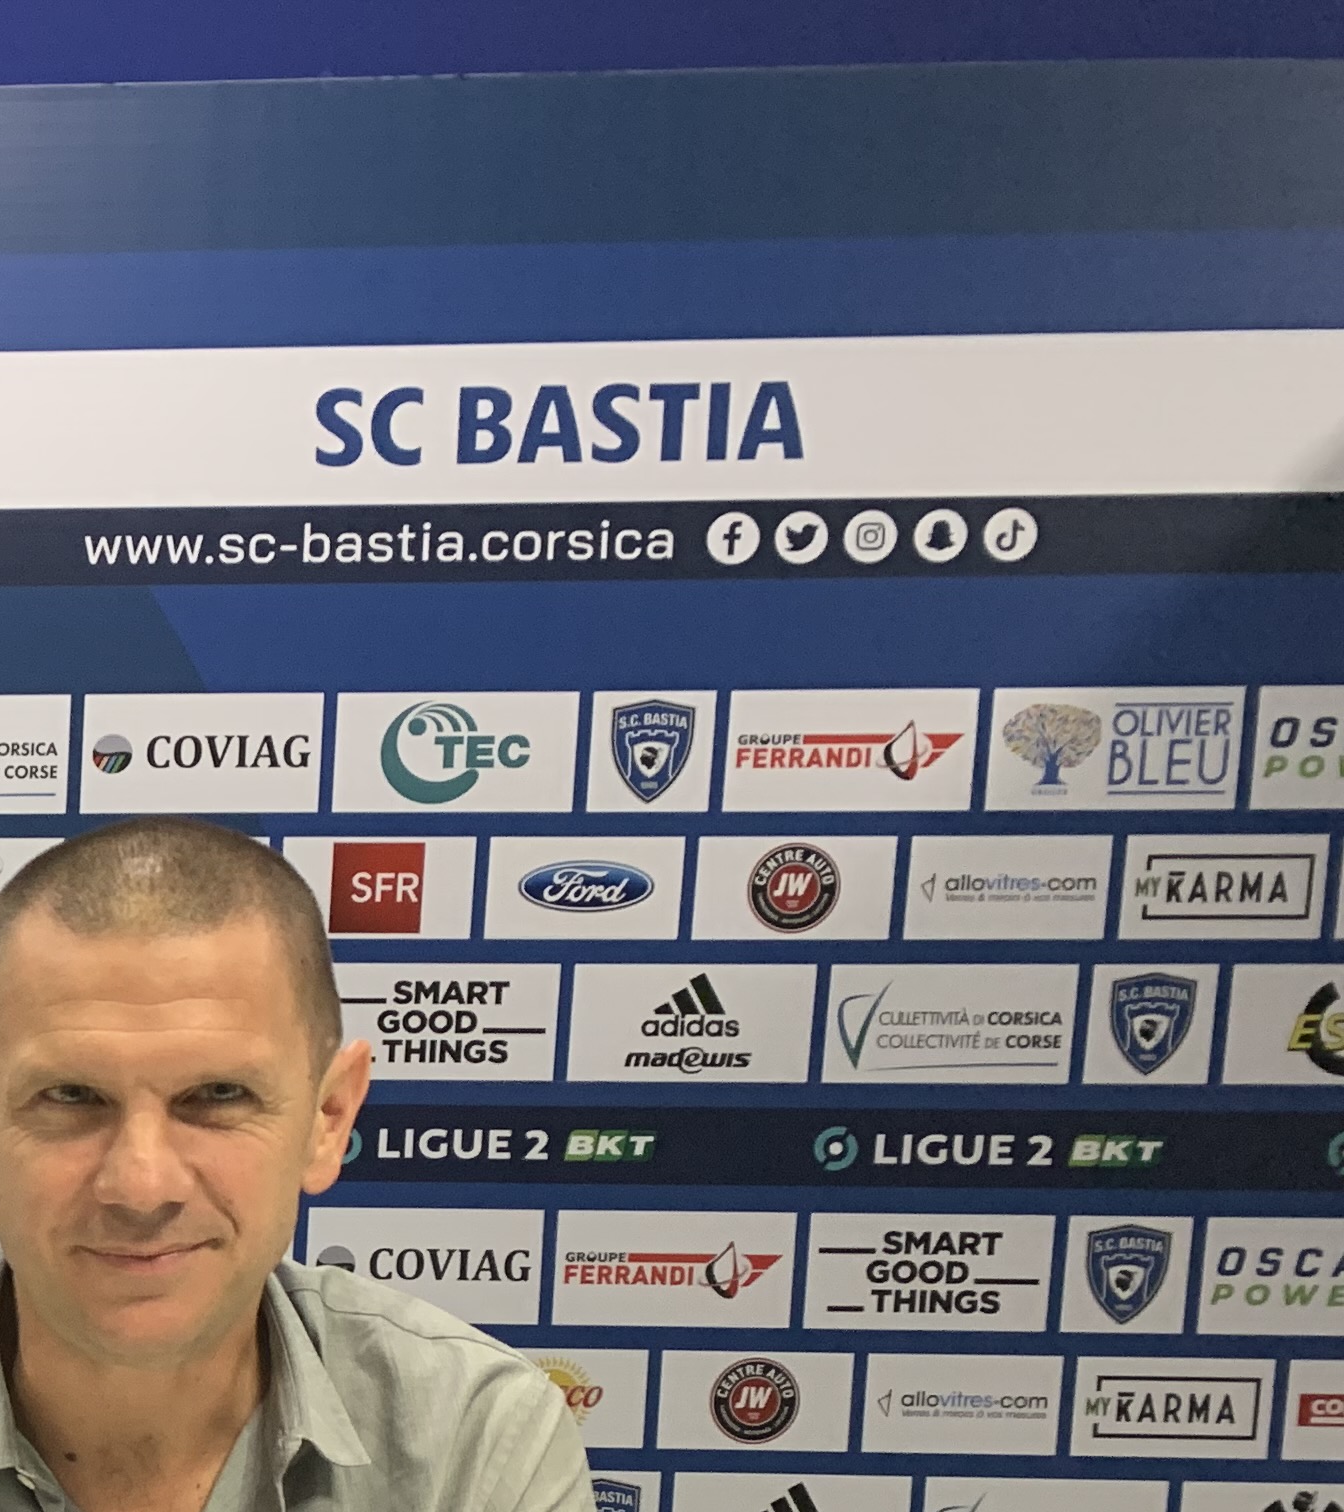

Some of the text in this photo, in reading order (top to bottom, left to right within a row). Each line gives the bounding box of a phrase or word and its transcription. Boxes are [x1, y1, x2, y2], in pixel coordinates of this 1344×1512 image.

[313, 380, 804, 467] SC BASTIA
[85, 519, 674, 567] www.sc-bastia.corsica
[618, 711, 688, 730] S.C. BASTIA
[1113, 709, 1231, 737] OLIVIER
[147, 734, 311, 769] COVIAG
[434, 734, 531, 769] TEC
[737, 734, 801, 746] GROUPE
[735, 747, 871, 768] FERRANDI
[1107, 739, 1230, 785] BLEU
[4, 765, 57, 780] CORSE
[351, 872, 419, 903] SFR
[543, 868, 626, 902] Ford
[1135, 871, 1288, 903] MY KARMA
[393, 981, 509, 1005] SMART
[377, 1010, 478, 1034] GOOD
[641, 1014, 740, 1037] adidas
[987, 1011, 1062, 1026] CORSICA
[383, 1039, 508, 1063] THINGS
[876, 1031, 1062, 1049] COLLECTIVITÉ DE CORSE
[377, 1128, 656, 1160] LIGUE 2 BKT
[873, 1134, 1163, 1165] LIGUE 2 BKT
[882, 1231, 1003, 1256] SMART
[369, 1248, 531, 1283] COVIAG
[866, 1260, 969, 1286] GOOD
[871, 1290, 1001, 1315] THINGS
[1210, 1283, 1344, 1307] POWE
[717, 1364, 794, 1398] CENTRE AUTO
[734, 1386, 772, 1408] JW
